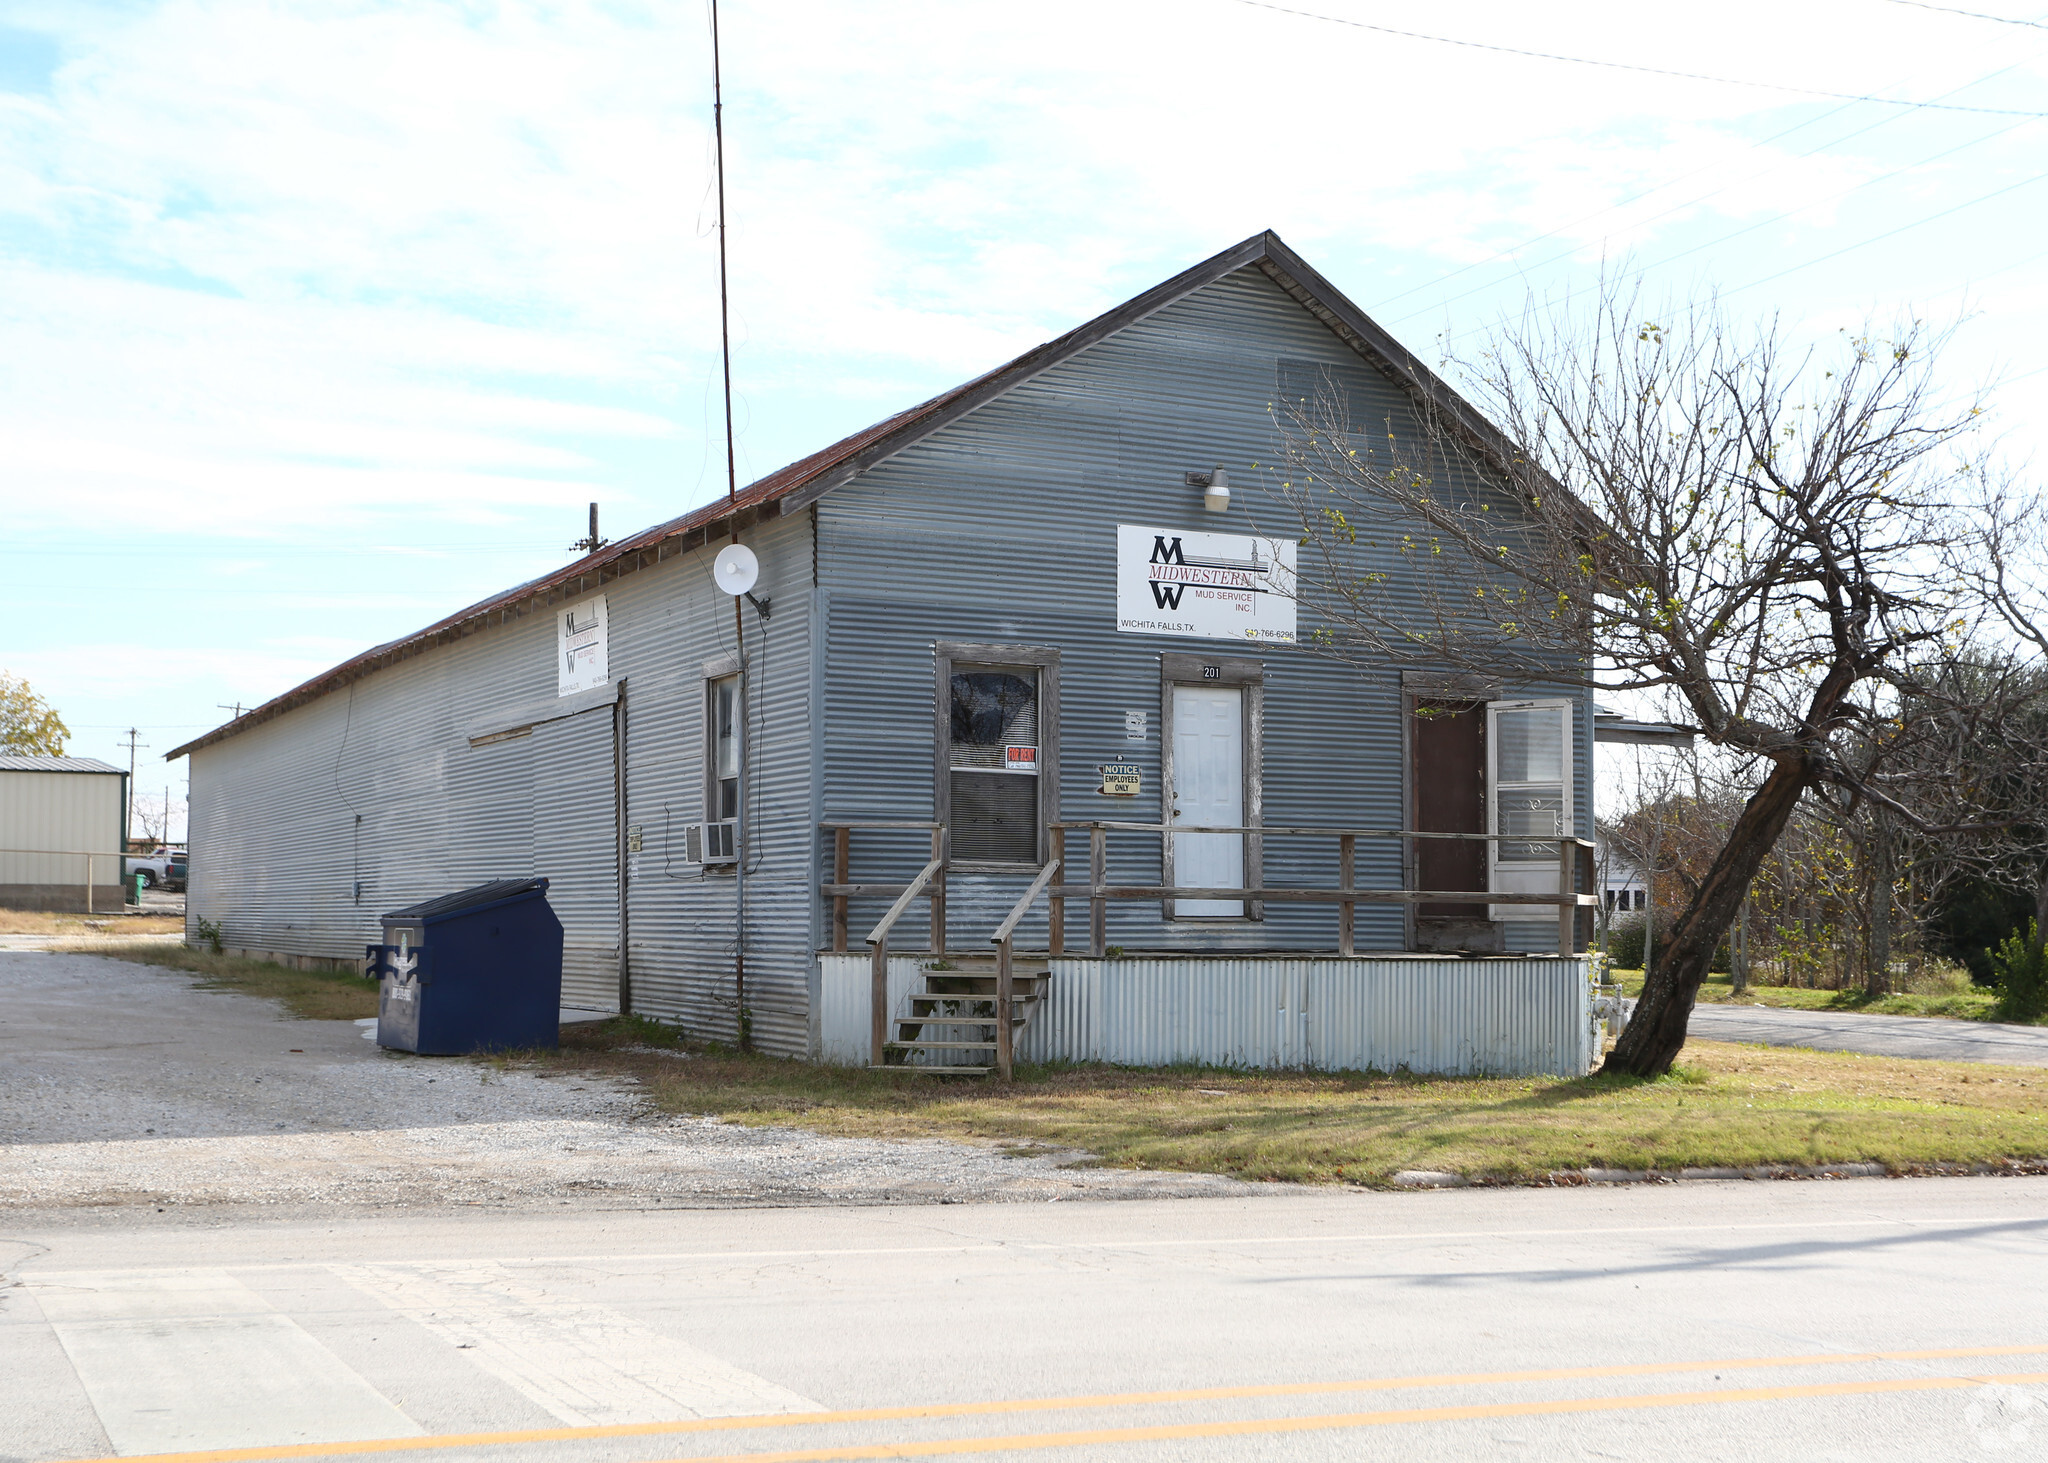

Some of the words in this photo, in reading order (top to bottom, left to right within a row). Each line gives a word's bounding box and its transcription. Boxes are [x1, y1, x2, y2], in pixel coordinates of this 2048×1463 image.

[1149, 536, 1185, 564] M
[1149, 565, 1252, 587] MIDWESTERN
[1149, 581, 1185, 610] W
[1195, 590, 1214, 599] MUD
[1217, 592, 1252, 602] SERVICE
[1235, 603, 1252, 612] INC.
[1121, 619, 1156, 629] WICHITA
[1204, 667, 1219, 678] 201
[1008, 748, 1019, 761] FOR
[1020, 748, 1035, 761] RENT
[1105, 765, 1138, 774] NOTICE
[1105, 775, 1139, 783] EMPLOYEES
